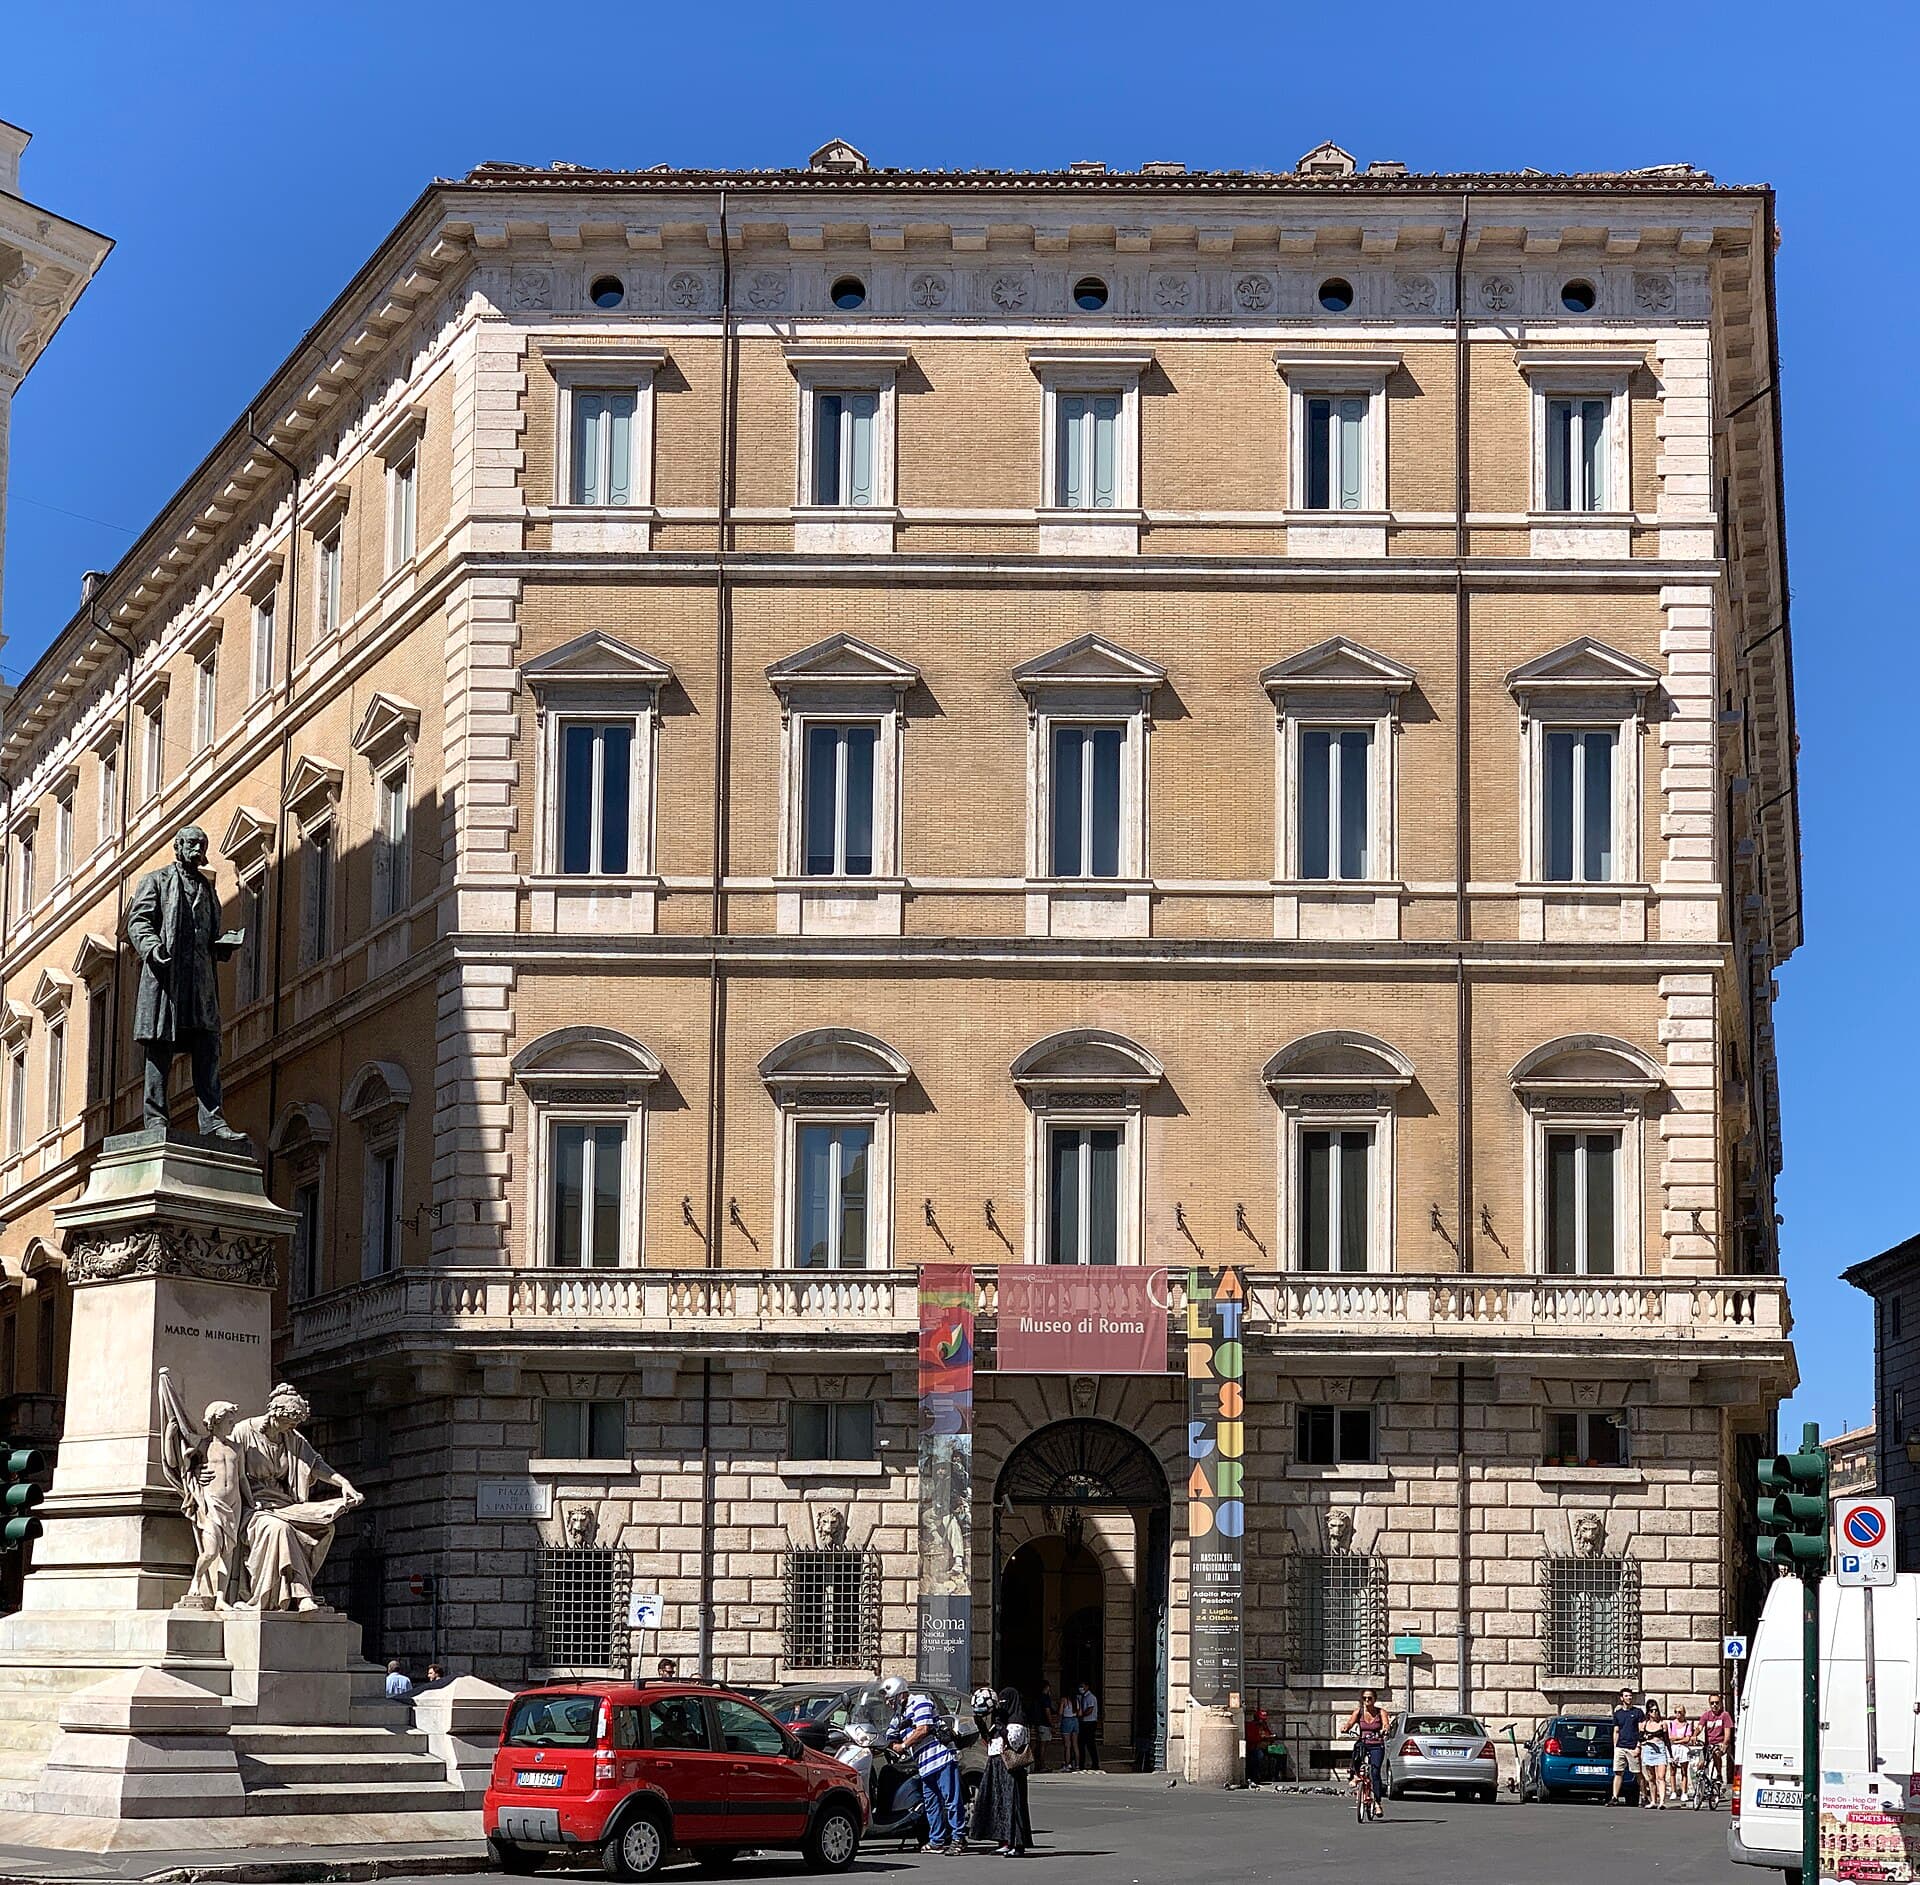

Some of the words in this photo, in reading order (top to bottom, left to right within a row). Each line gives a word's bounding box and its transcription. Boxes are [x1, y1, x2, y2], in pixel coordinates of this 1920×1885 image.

[1020, 1317, 1072, 1333] Museo
[1078, 1317, 1092, 1333] di
[1099, 1318, 1144, 1333] Roma
[164, 1324, 200, 1337] MARCO
[205, 1329, 260, 1344] MINGHETTI
[498, 1487, 531, 1496] PIAZZA
[1200, 1553, 1223, 1562] NASCITA
[1223, 1553, 1233, 1562] DEL
[1192, 1563, 1241, 1572] FOTOGIORNALISMO
[1846, 1558, 1857, 1571] P
[1212, 1573, 1229, 1581] ITALIA
[921, 1613, 965, 1630] Roma
[921, 1630, 945, 1638] Nascita
[921, 1637, 928, 1645] di
[940, 1637, 965, 1646] capitale
[921, 1645, 935, 1653] 1870
[943, 1645, 955, 1654] 1915
[1755, 1752, 1783, 1760] TRANSIT
[1762, 1791, 1774, 1803] CM
[1774, 1792, 1803, 1805] 328SN
[1851, 1814, 1881, 1822] TICKETS
